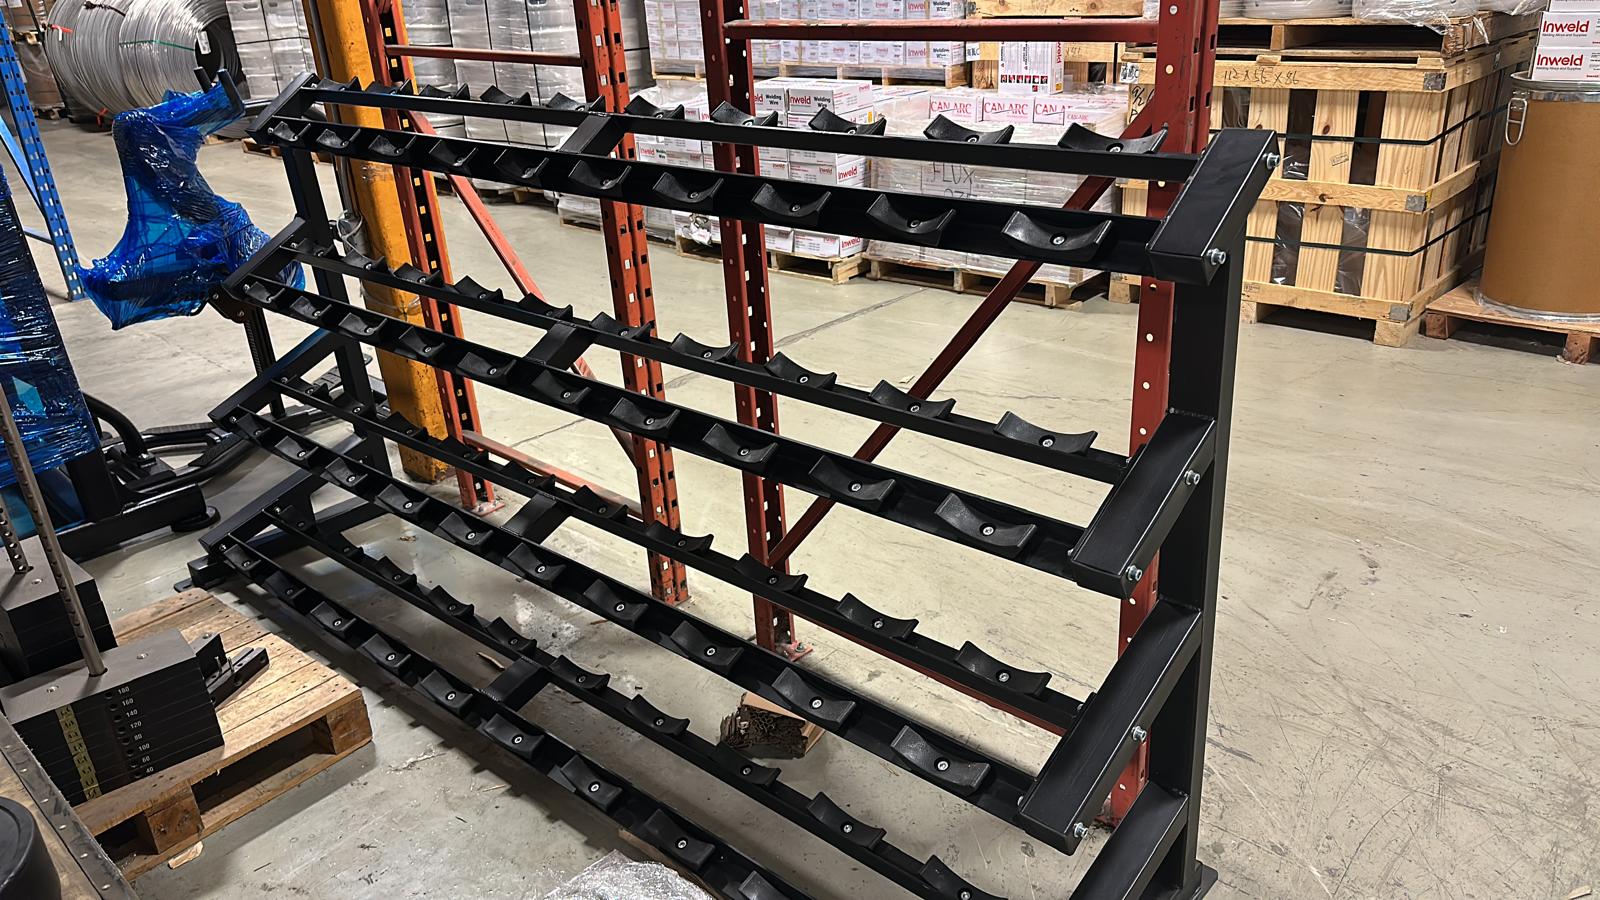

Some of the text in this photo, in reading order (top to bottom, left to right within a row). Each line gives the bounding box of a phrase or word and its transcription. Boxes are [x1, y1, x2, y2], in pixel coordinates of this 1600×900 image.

[907, 2, 926, 10] Inwel
[1543, 20, 1590, 33] Inweld
[907, 48, 926, 57] Inwel
[1537, 54, 1584, 66] Inweld
[930, 100, 972, 114] CAN ARC
[984, 101, 1028, 116] CAN ARC
[1035, 103, 1058, 116] CAN
[838, 165, 858, 180] Inweld
[122, 698, 134, 706] 160
[126, 709, 138, 717] 140
[130, 720, 142, 729] 120
[138, 743, 150, 752] 100
[146, 766, 154, 774] 40
